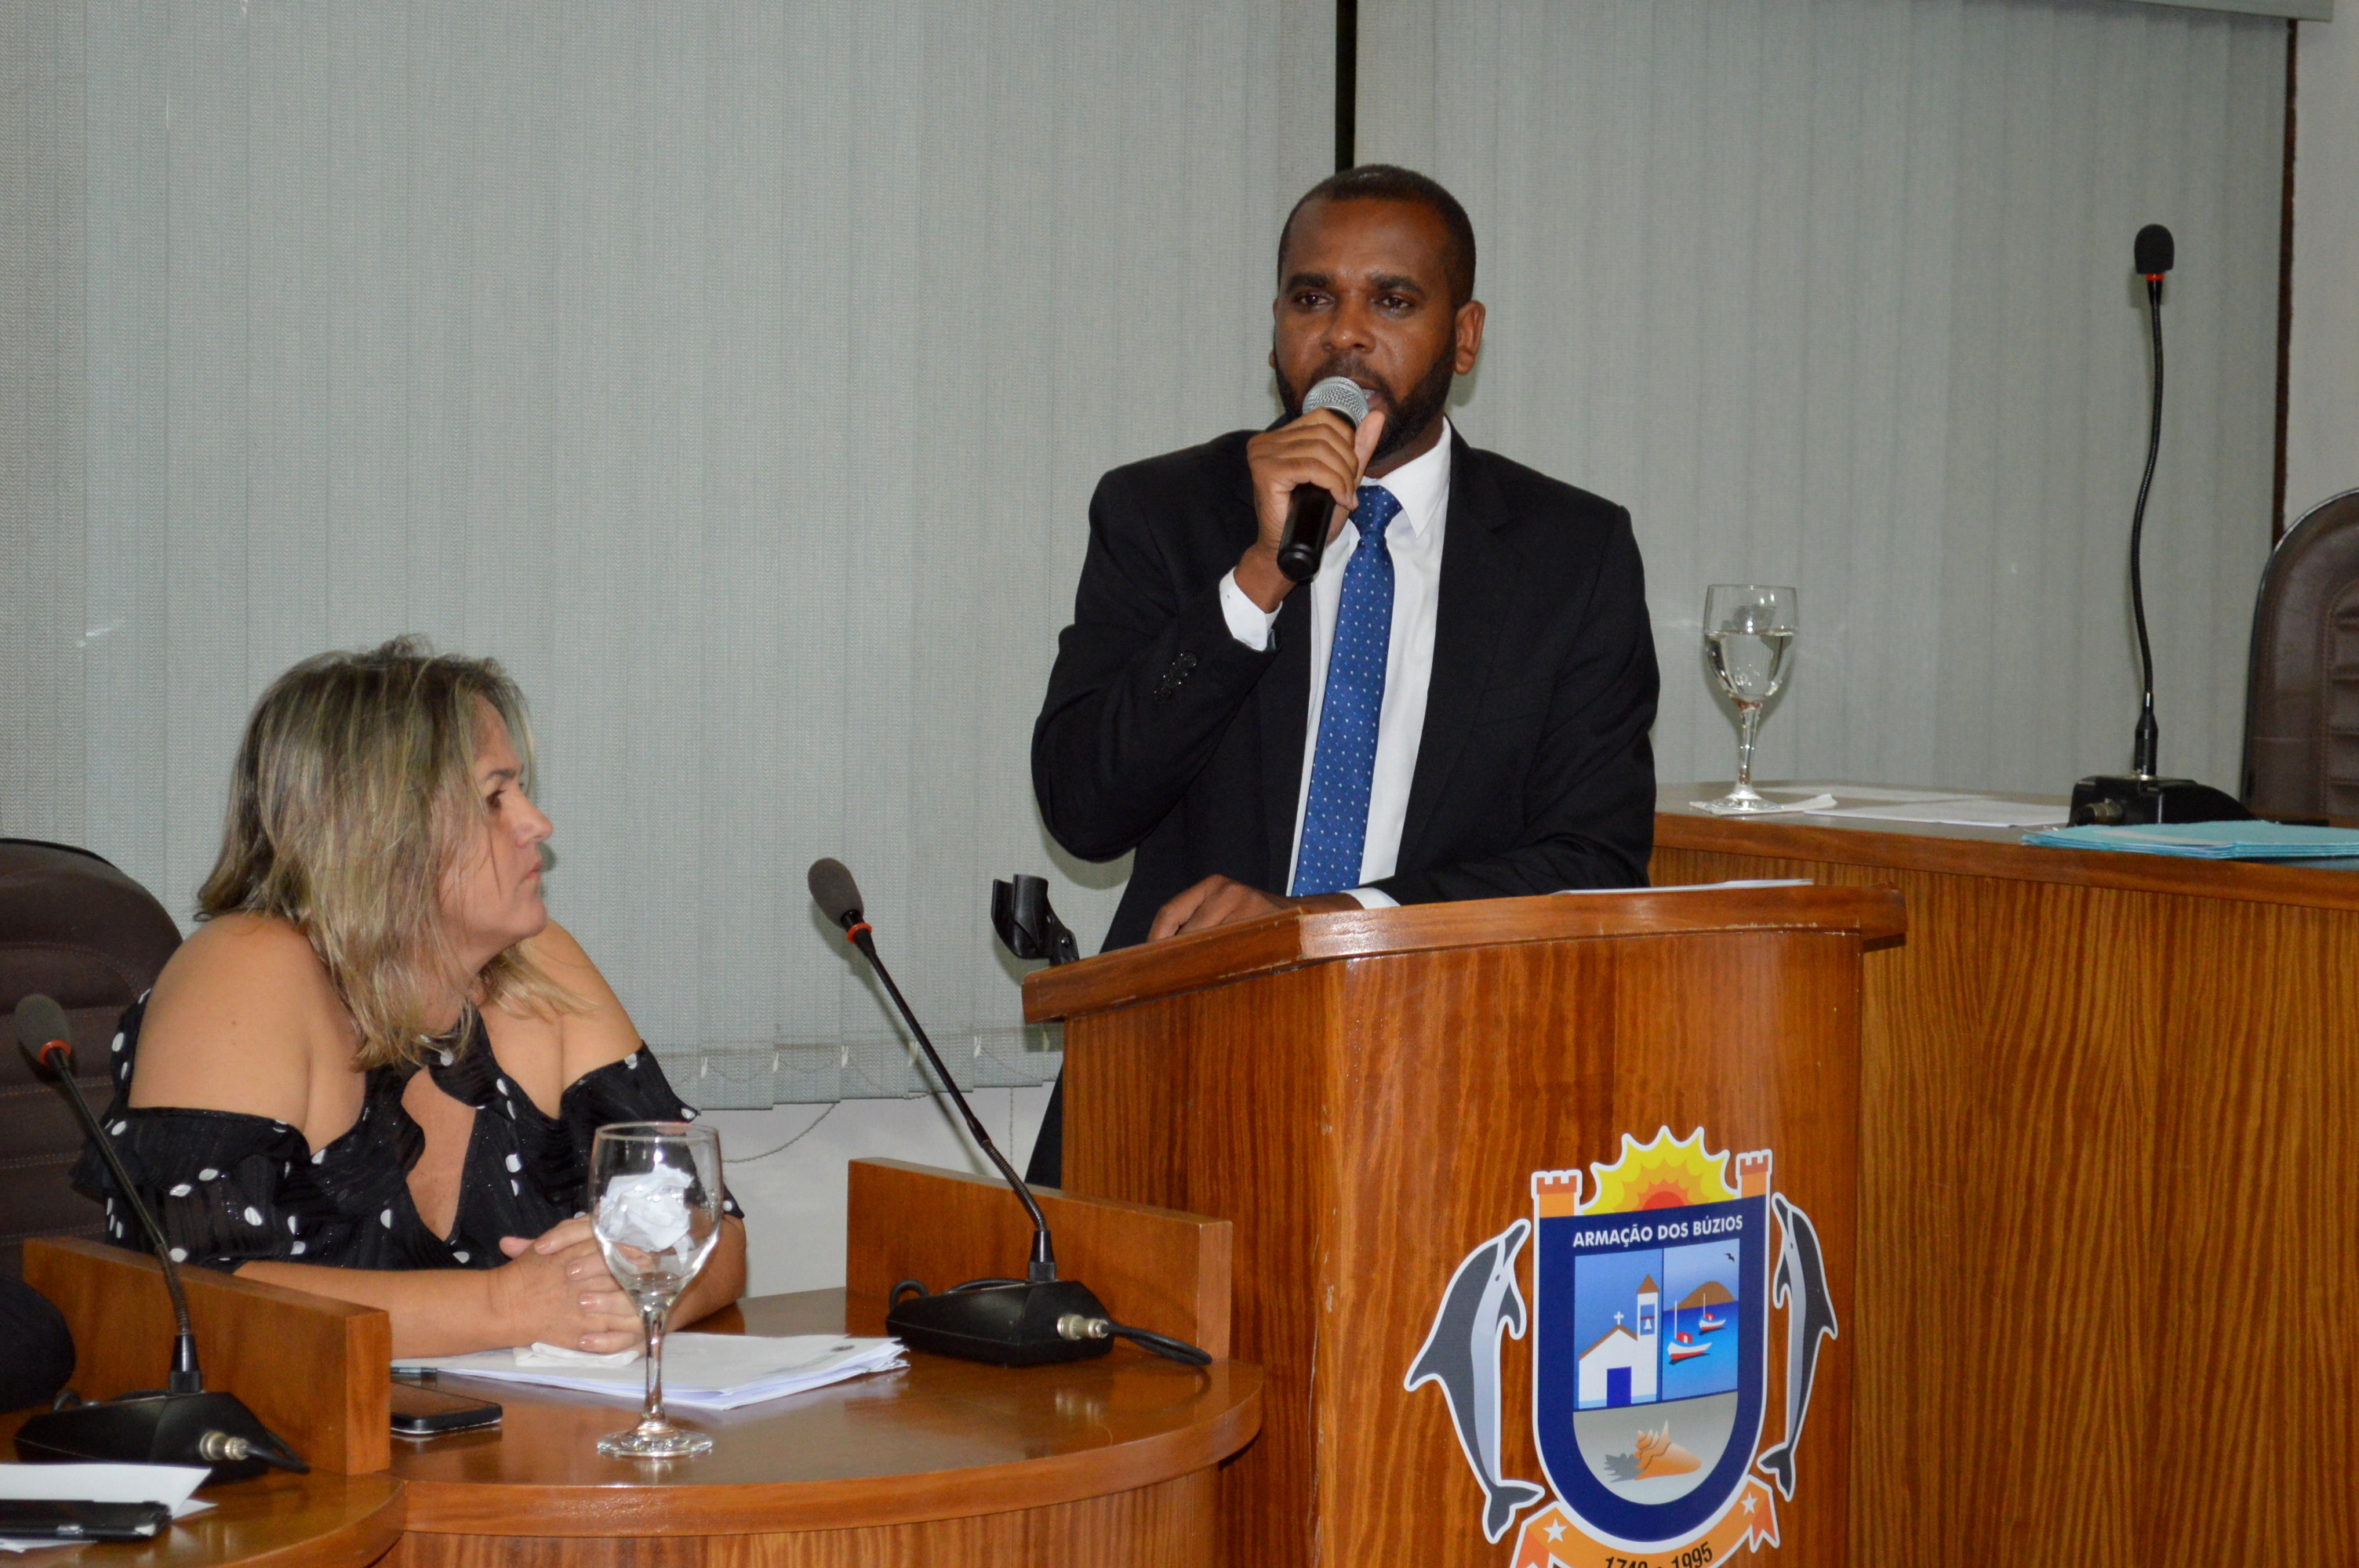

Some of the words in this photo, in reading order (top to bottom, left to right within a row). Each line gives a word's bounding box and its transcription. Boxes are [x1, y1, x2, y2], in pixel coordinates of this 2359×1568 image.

[1572, 1224, 1653, 1247] ARMAÇÃO
[1658, 1222, 1688, 1240] DOS
[1692, 1214, 1743, 1236] BÚZIOS
[1670, 1541, 1713, 1568] 1995
